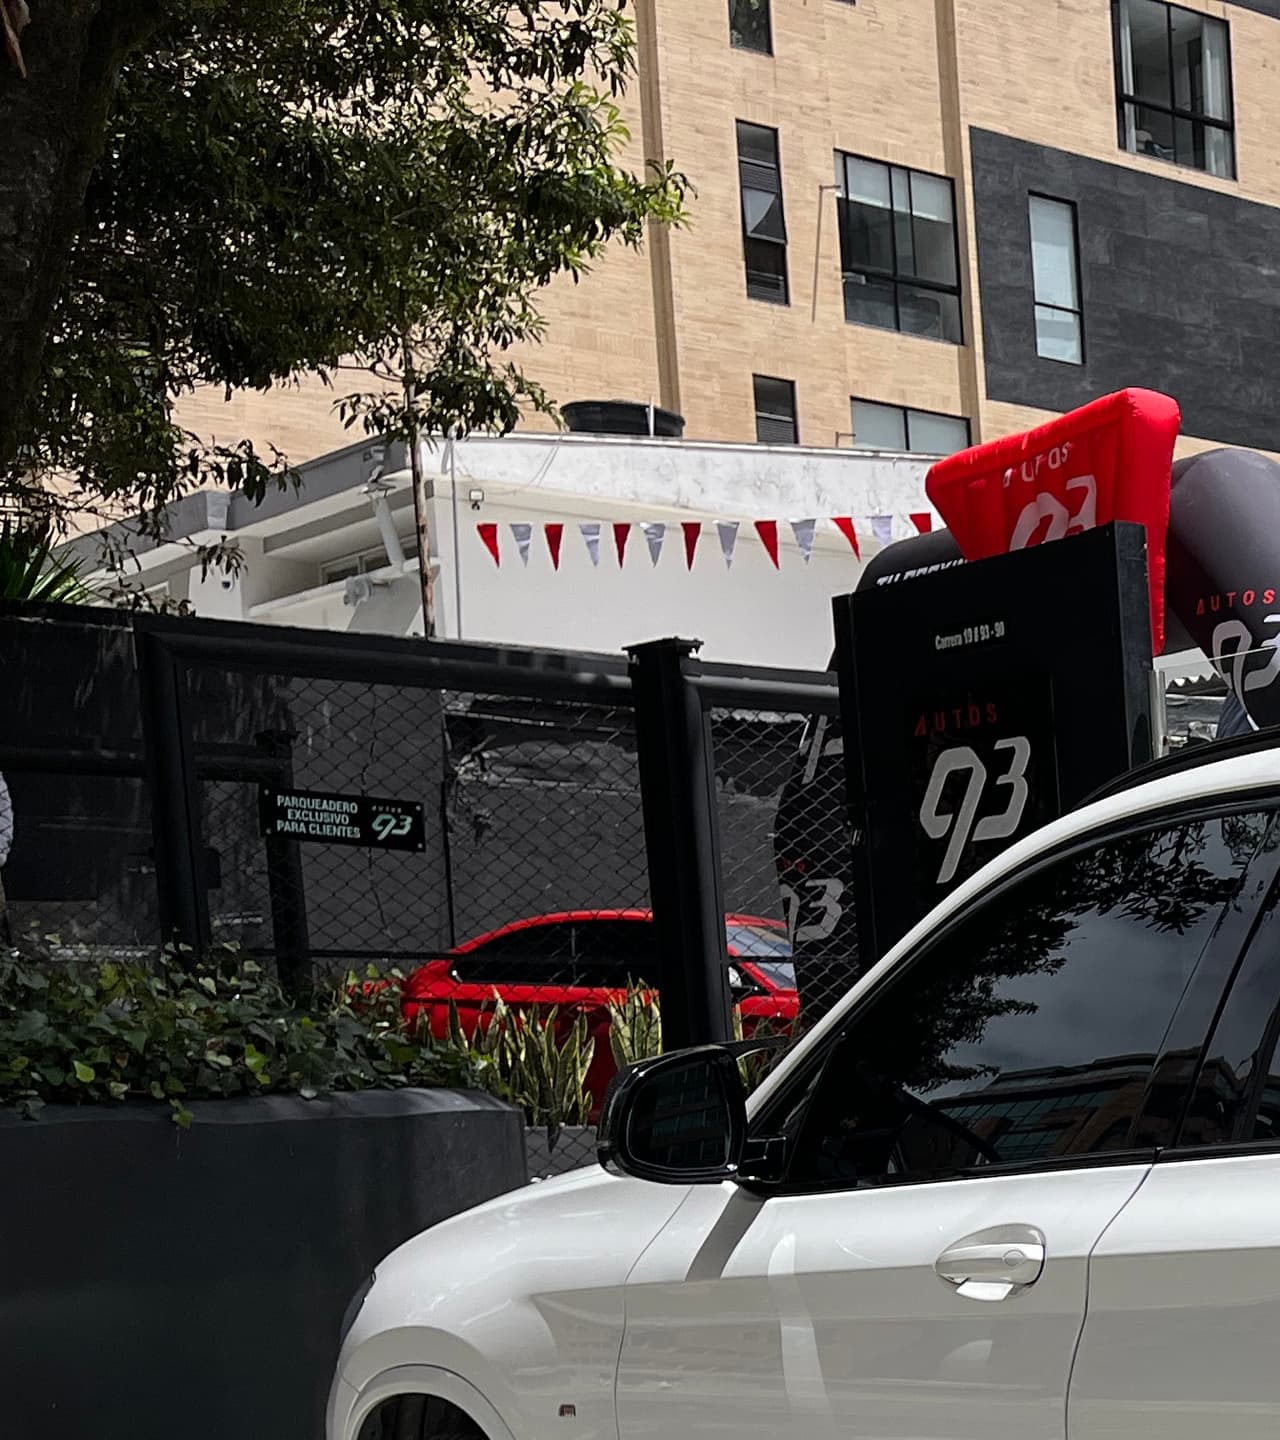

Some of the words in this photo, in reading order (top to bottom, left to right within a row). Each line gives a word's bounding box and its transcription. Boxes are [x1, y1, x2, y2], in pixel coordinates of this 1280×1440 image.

[1196, 588, 1276, 615] AUTOS
[935, 634, 963, 650] Carrera
[914, 702, 998, 737] AUTOS
[276, 795, 359, 813] PARQUEADERO
[919, 735, 1031, 884] 93
[287, 809, 350, 825] EXCLUSIVO
[371, 813, 413, 841] 93
[276, 820, 307, 834] PARA
[309, 823, 361, 839] CLIENTES
